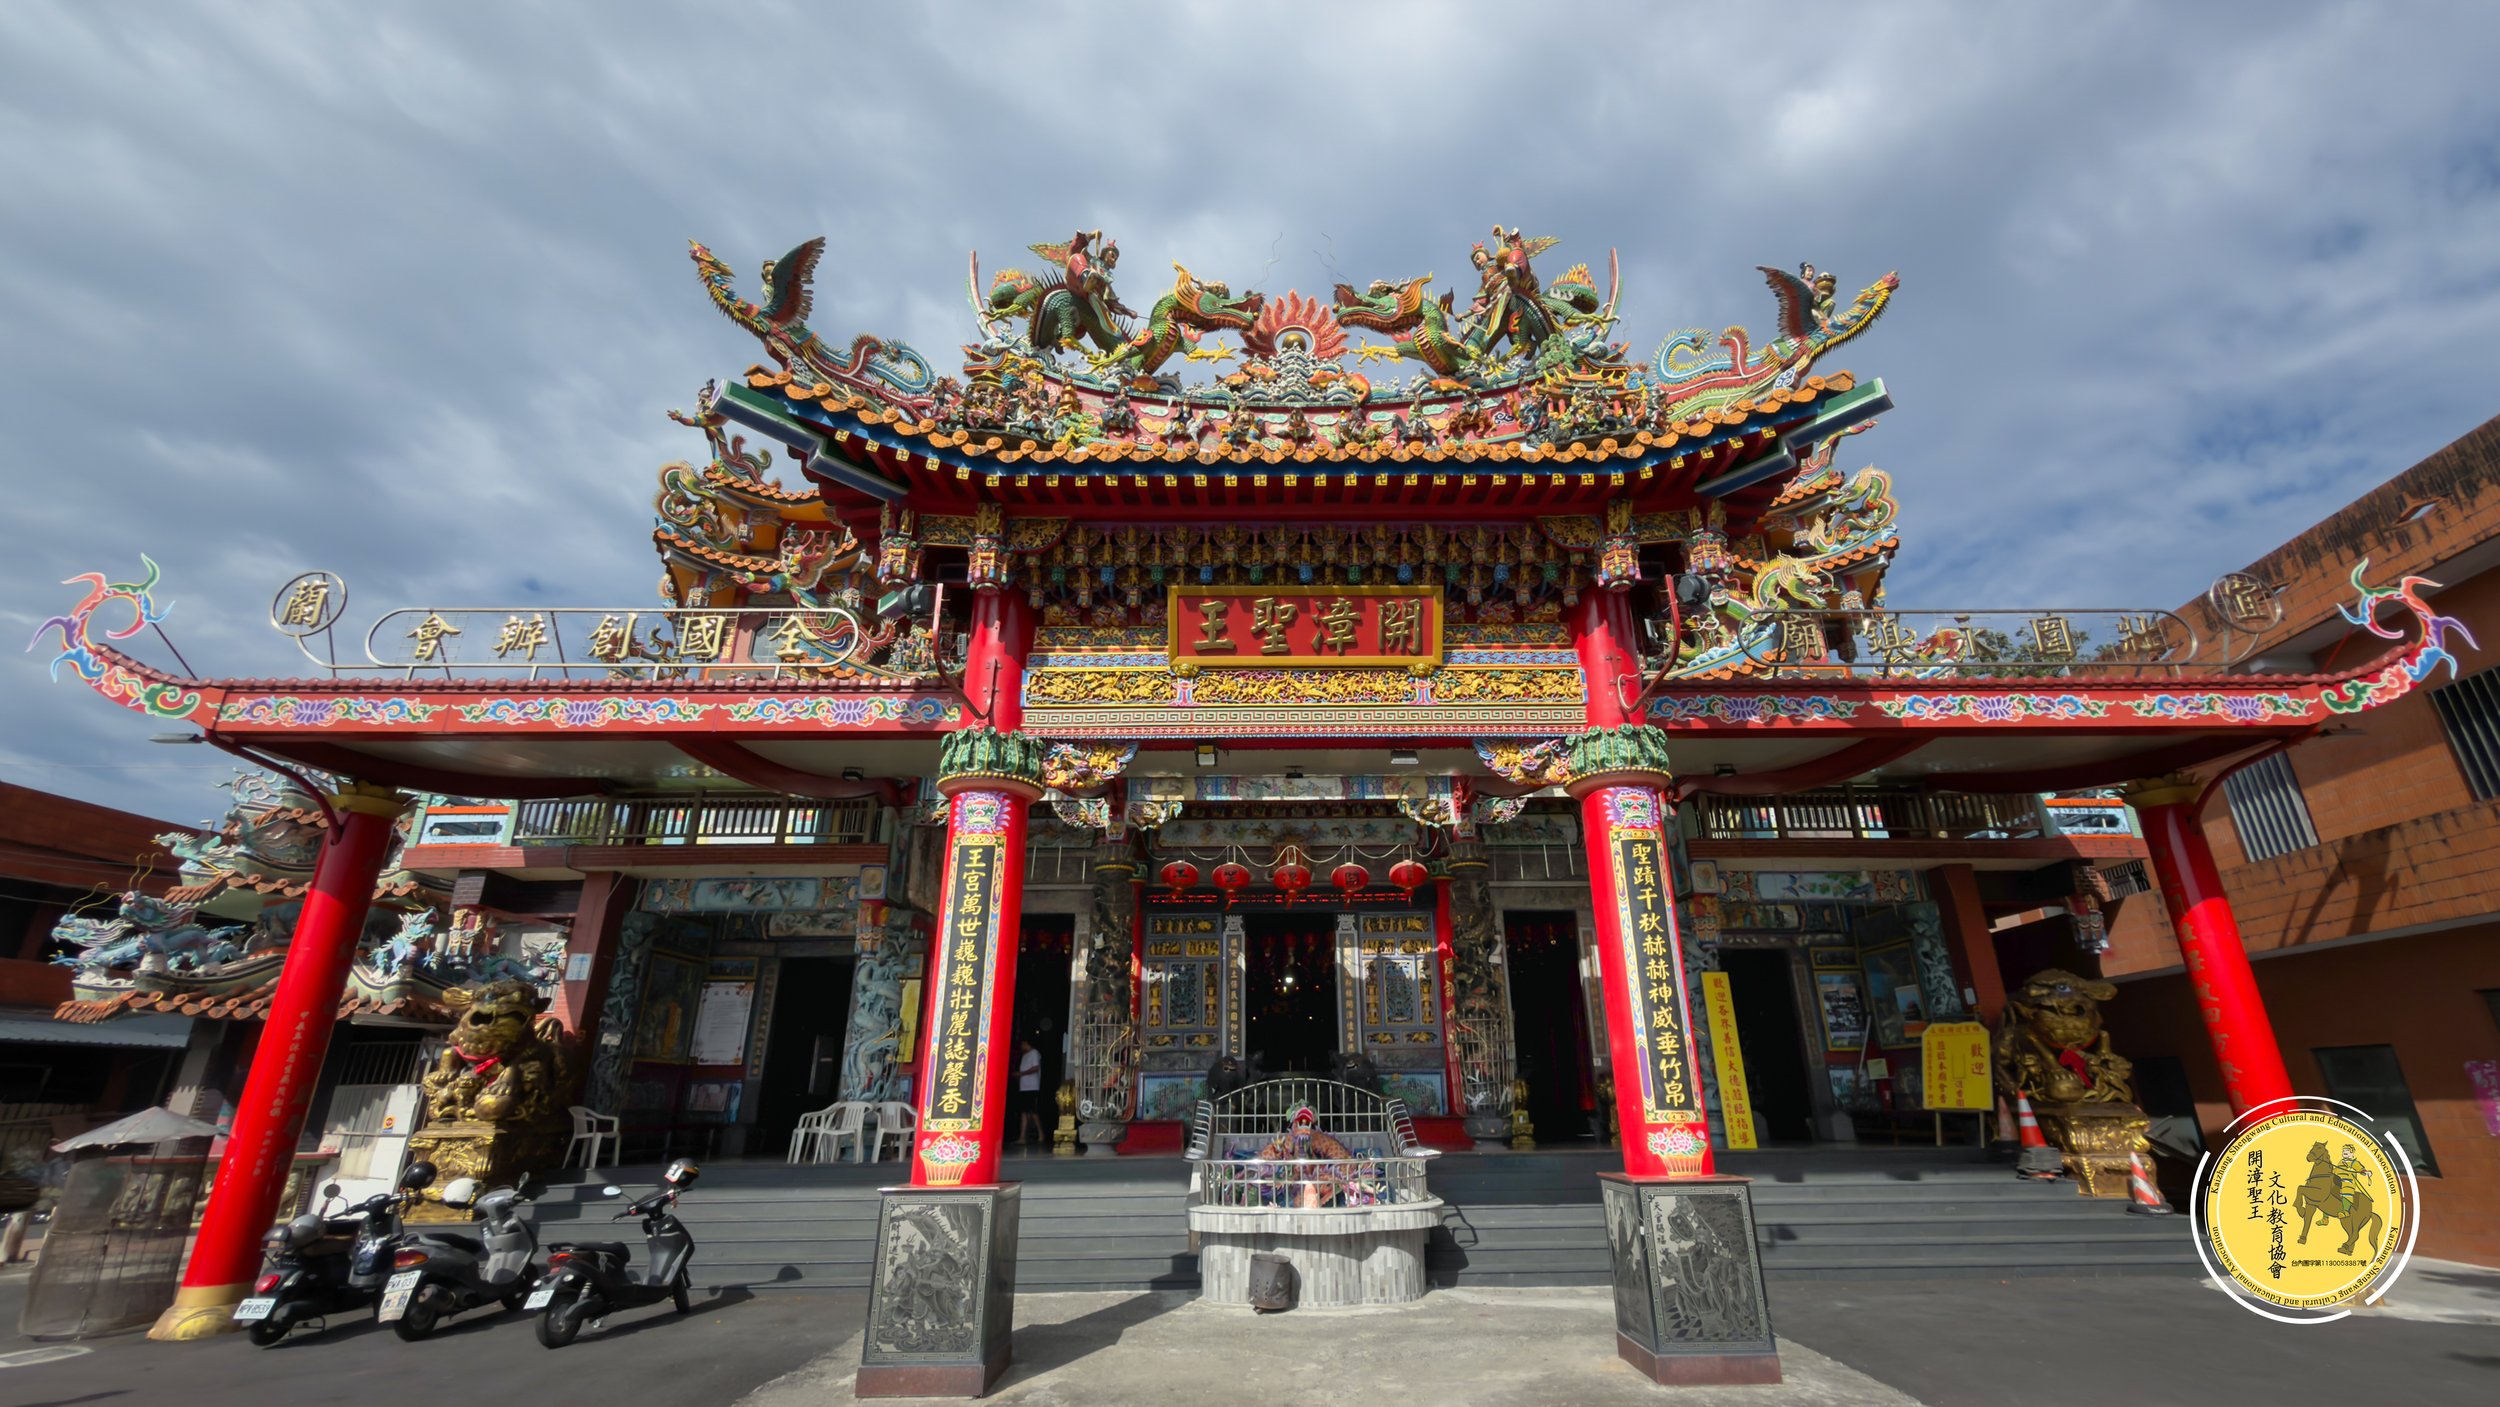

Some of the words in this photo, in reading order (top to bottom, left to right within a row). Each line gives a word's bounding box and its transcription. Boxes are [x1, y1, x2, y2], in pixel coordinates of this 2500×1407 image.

[281, 579, 329, 629] 蘭
[1192, 596, 1422, 655] 開漳聖王
[936, 849, 987, 1114] 王宮萬世巍巍壯麗誌馨香
[1631, 842, 1687, 1107] 聖蹟千秋赫赫神威垂竹帛
